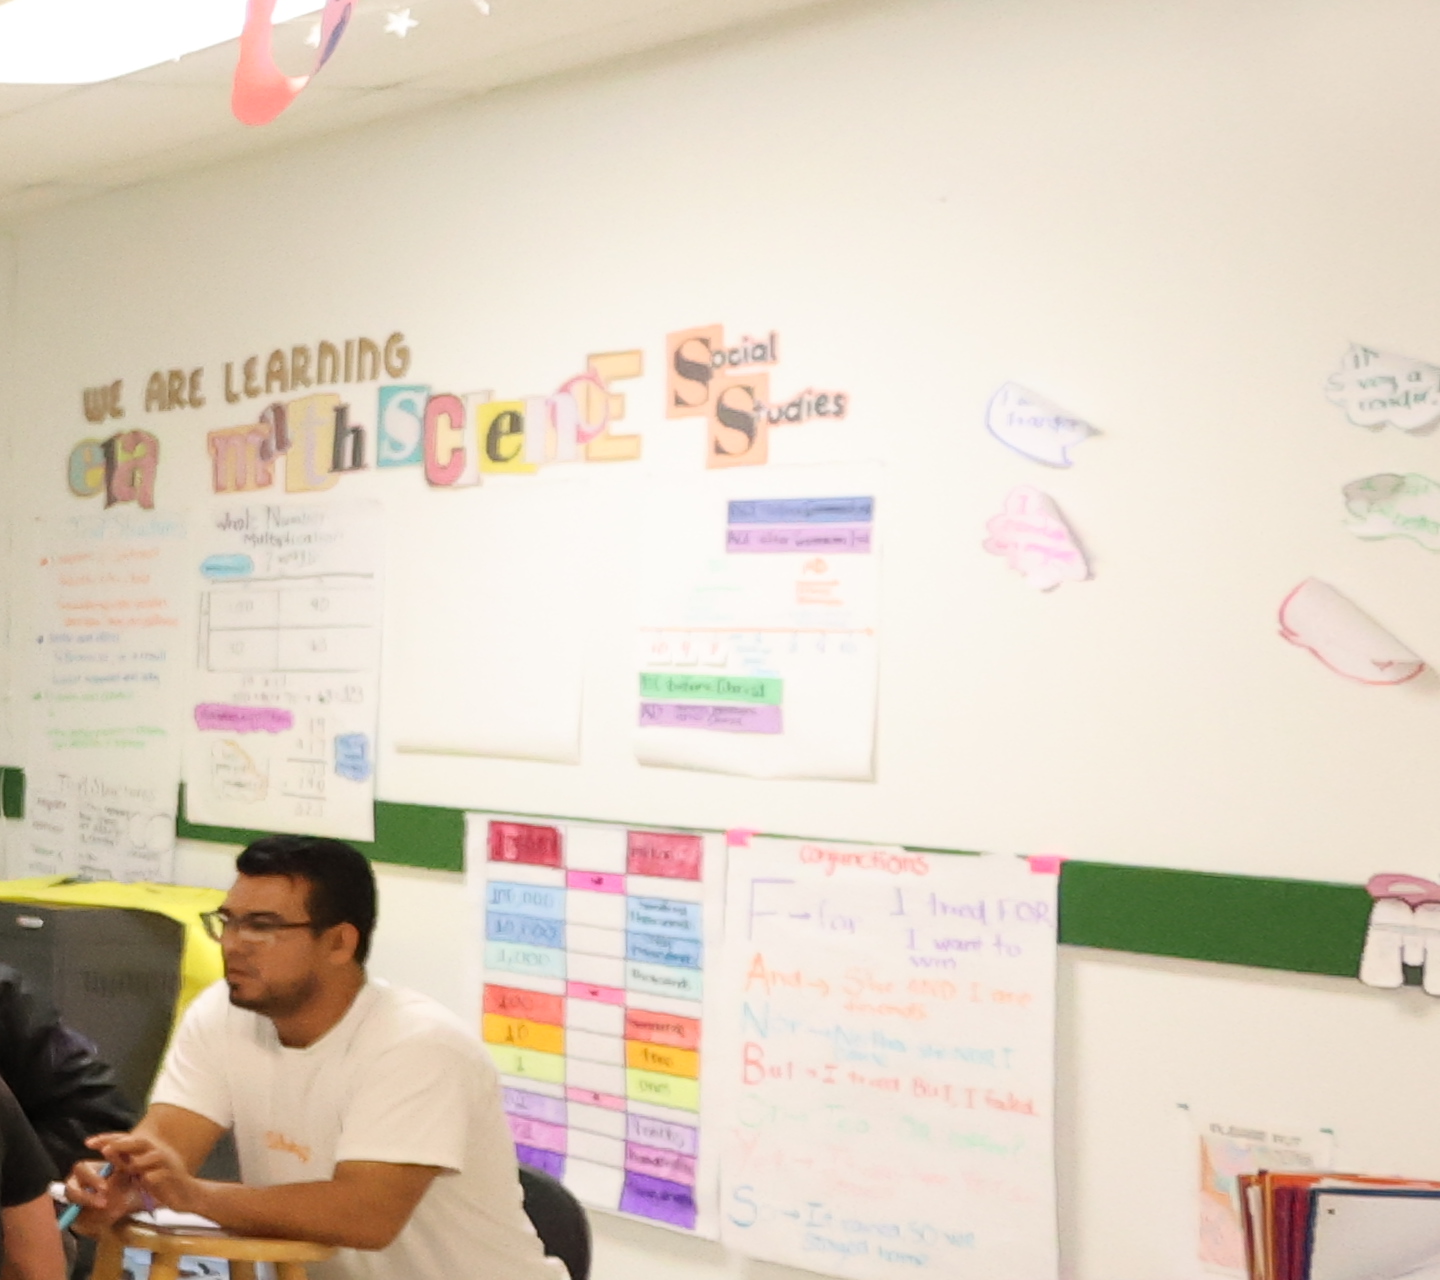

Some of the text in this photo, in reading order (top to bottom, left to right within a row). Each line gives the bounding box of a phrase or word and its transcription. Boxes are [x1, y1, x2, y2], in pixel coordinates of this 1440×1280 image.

[83, 331, 412, 425] WE ARE LEARNING
[673, 334, 779, 410] Social
[713, 381, 849, 458] Studies
